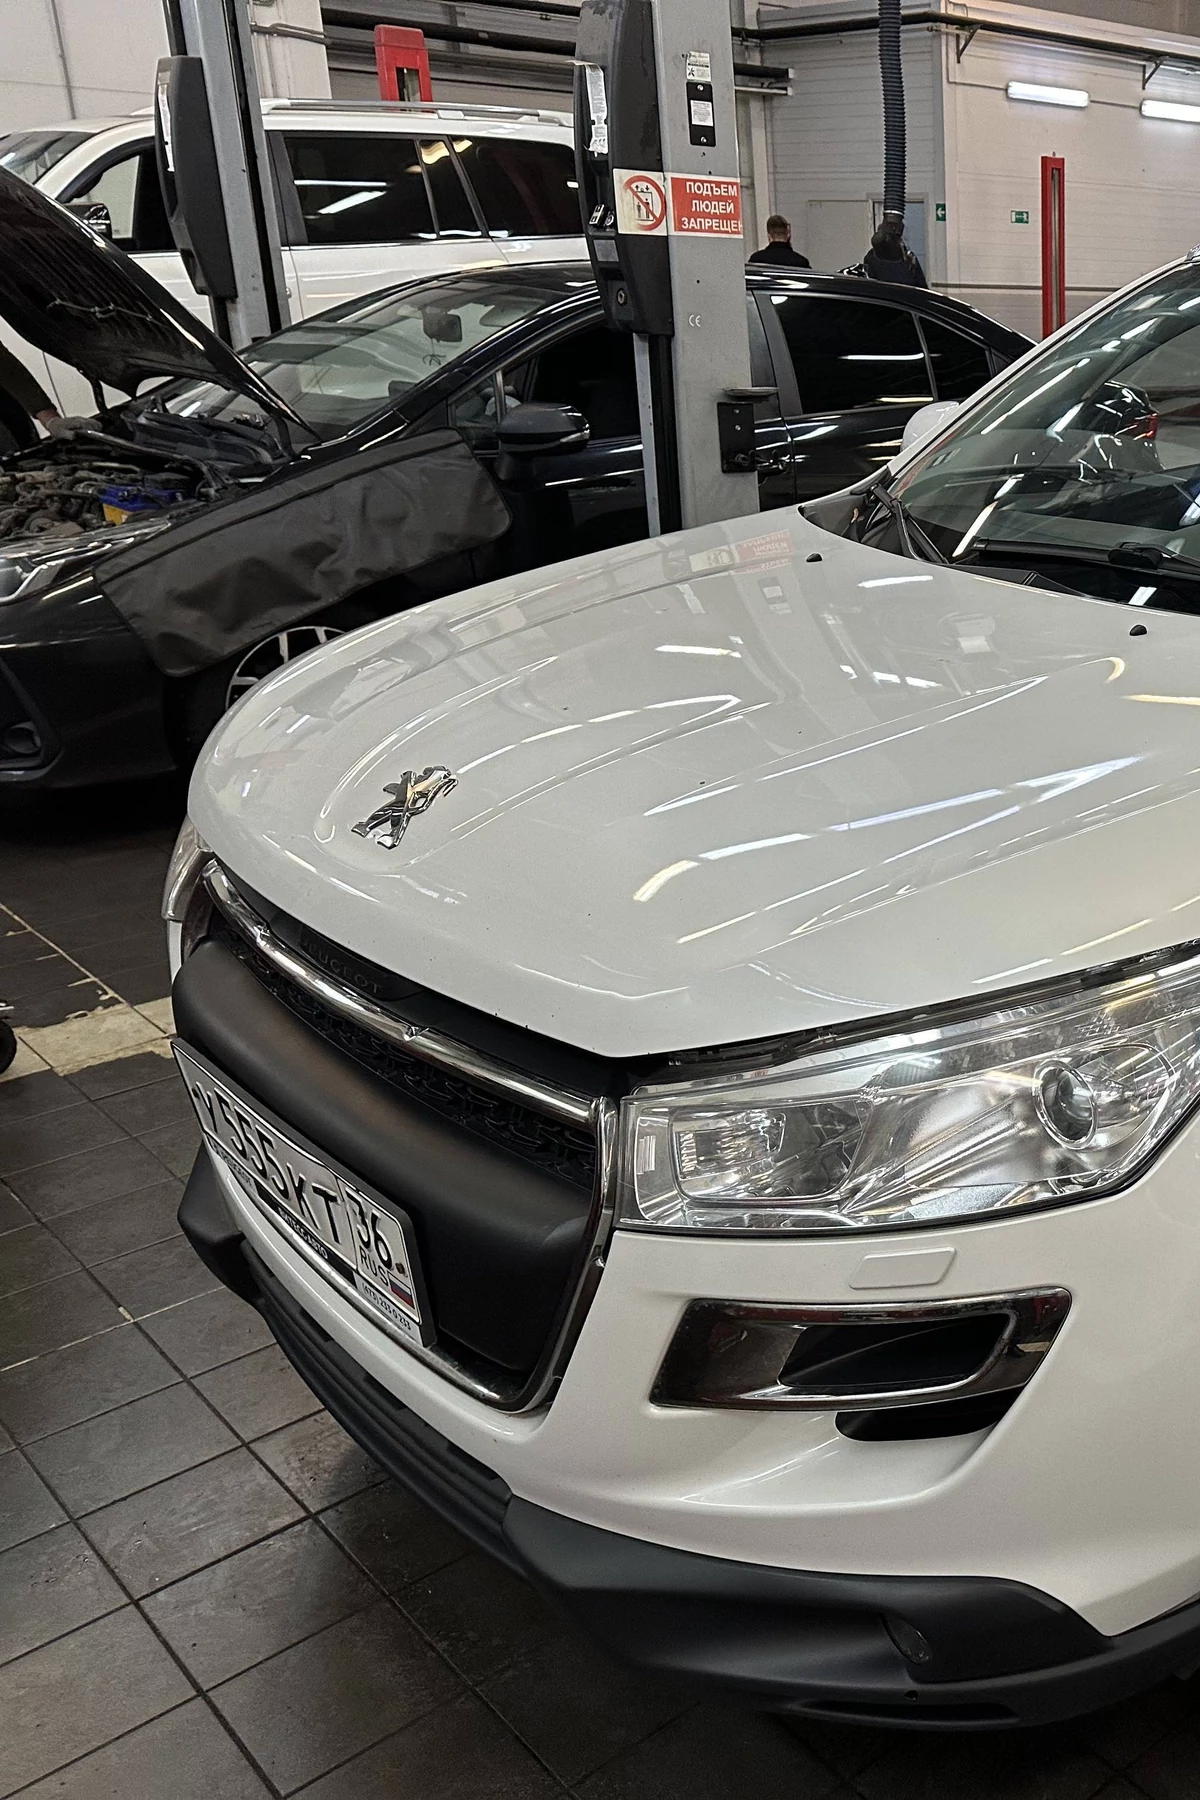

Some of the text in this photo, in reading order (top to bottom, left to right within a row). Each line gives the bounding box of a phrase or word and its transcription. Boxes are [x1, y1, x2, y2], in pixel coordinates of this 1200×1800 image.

[686, 182, 737, 196] ПОДЪЕМ
[692, 200, 734, 214] ЛЮДЕЙ
[303, 941, 383, 994] EUGEOT
[345, 1188, 393, 1270] 36
[359, 1246, 389, 1287] RUS
